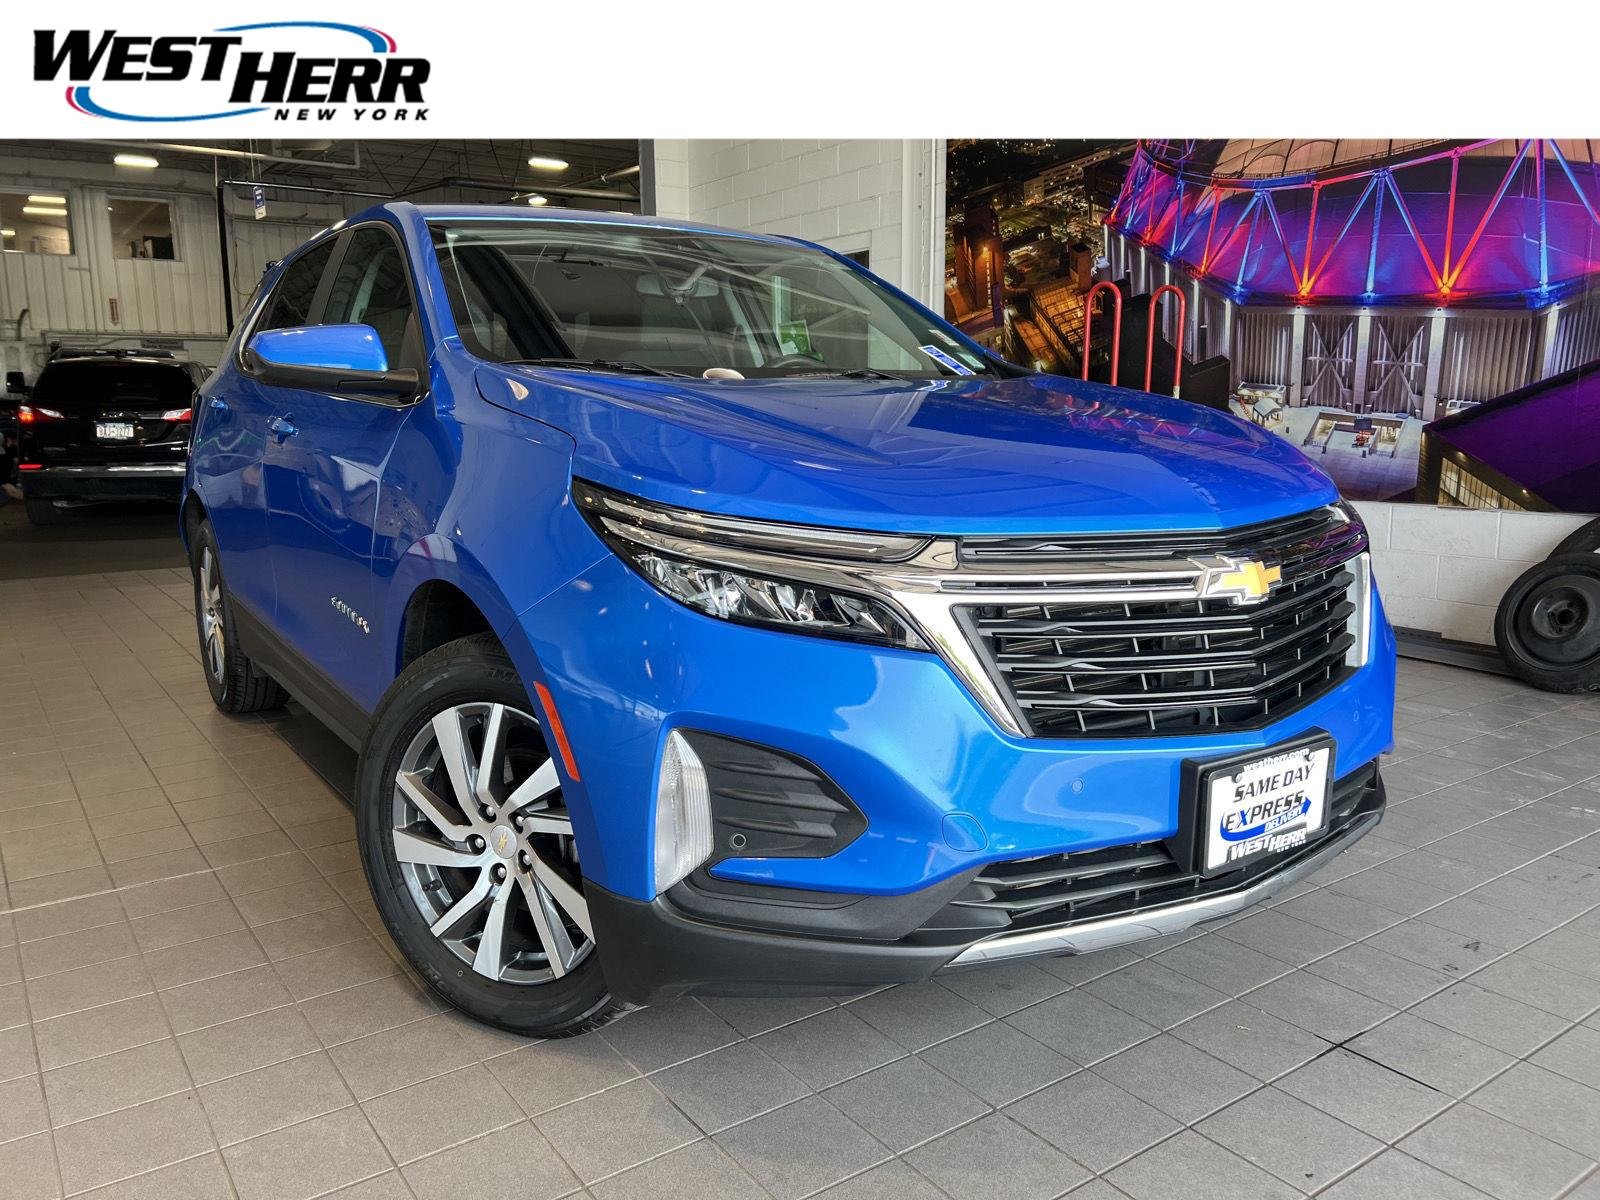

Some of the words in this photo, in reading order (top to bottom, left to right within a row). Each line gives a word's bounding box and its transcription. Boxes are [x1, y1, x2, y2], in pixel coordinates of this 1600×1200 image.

[1243, 748, 1310, 773] westherr.com
[1233, 774, 1281, 803] SAME
[1282, 762, 1315, 789] DAY
[1226, 790, 1305, 832] EXPRESS
[1264, 808, 1301, 833] DELIVERY
[1230, 833, 1273, 861] WEST
[1268, 827, 1307, 852] HERR
